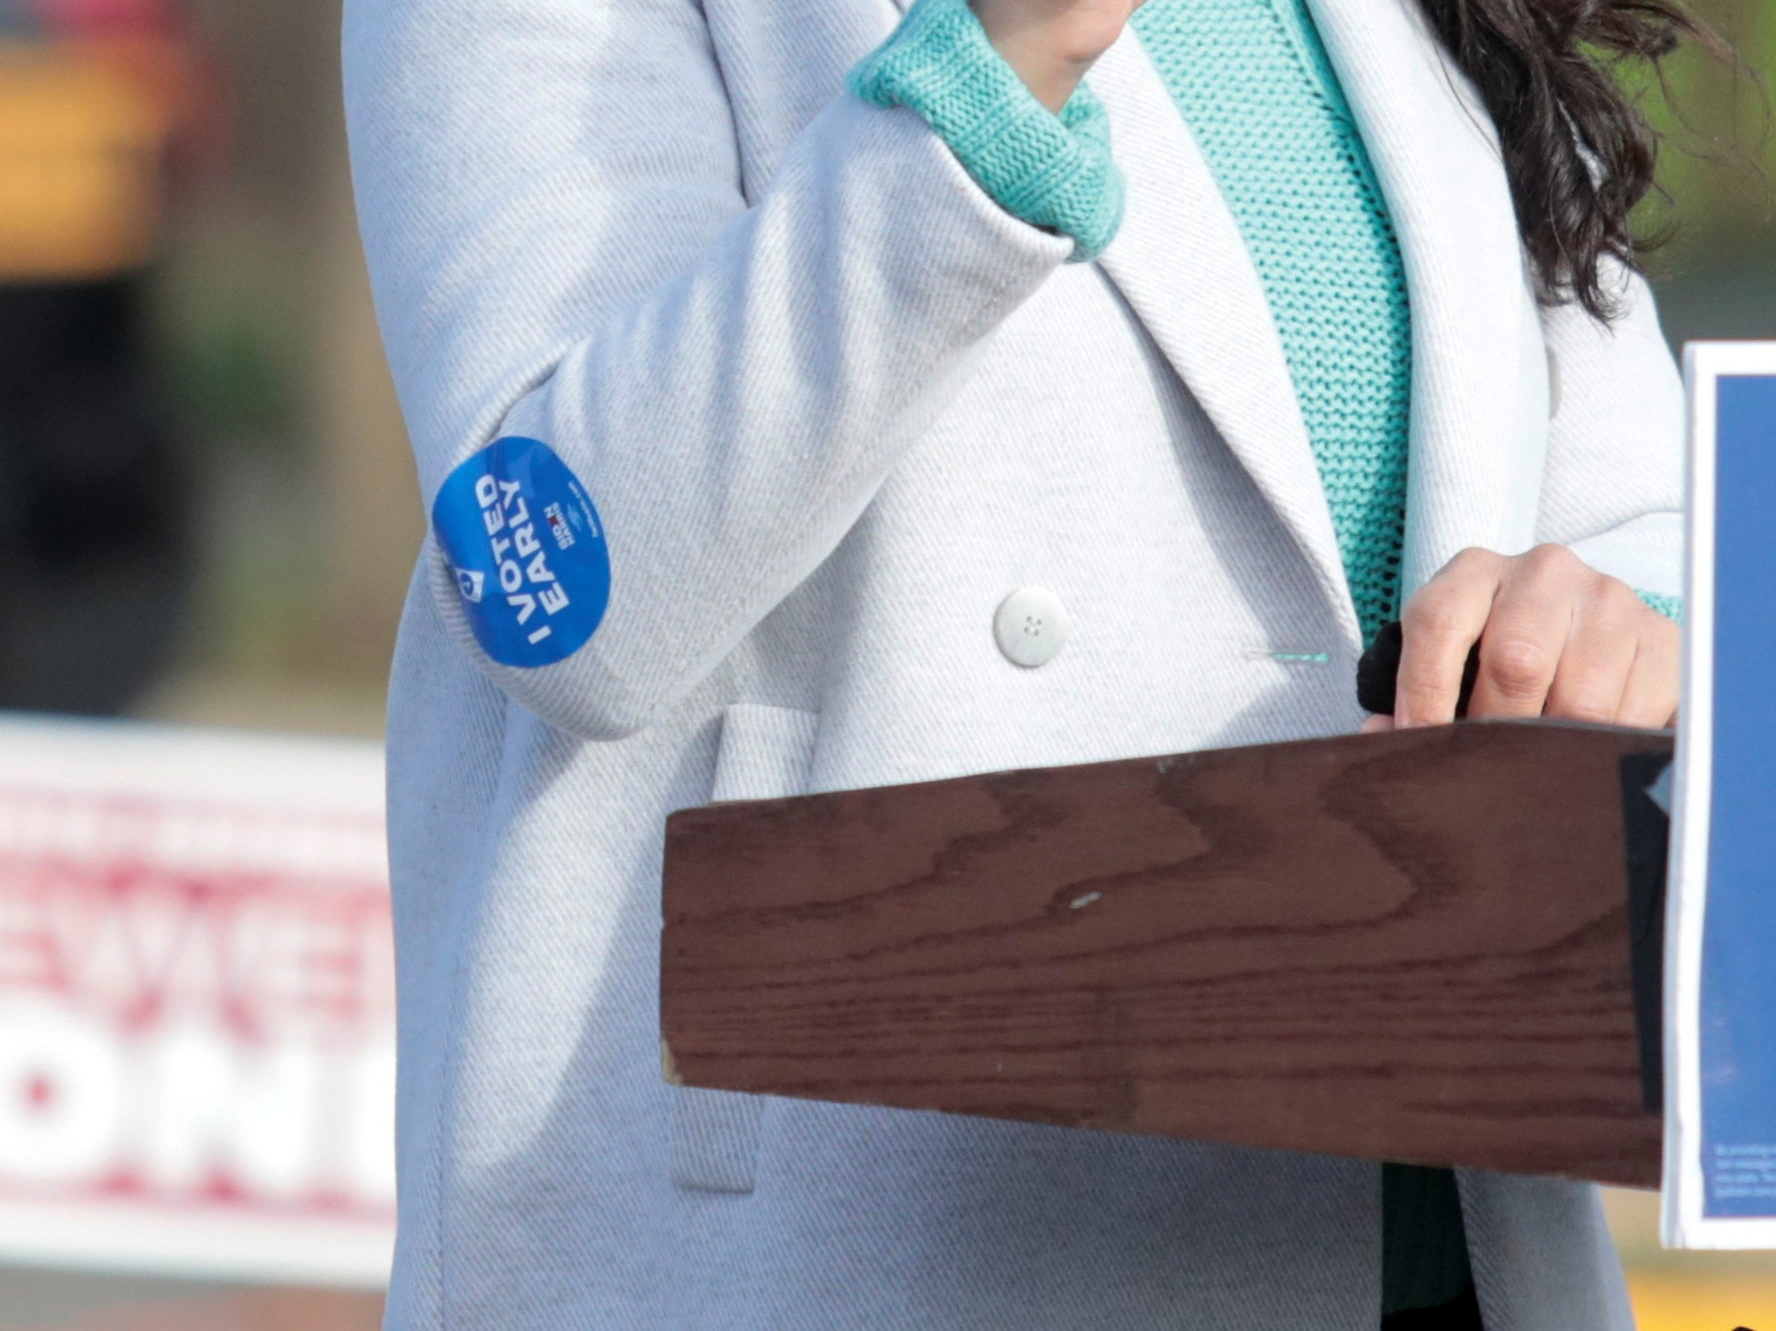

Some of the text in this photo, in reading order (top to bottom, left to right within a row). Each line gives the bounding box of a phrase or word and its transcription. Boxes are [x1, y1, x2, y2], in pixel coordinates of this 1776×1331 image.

[475, 474, 551, 644] I VOTED
[499, 479, 569, 615] EARLY
